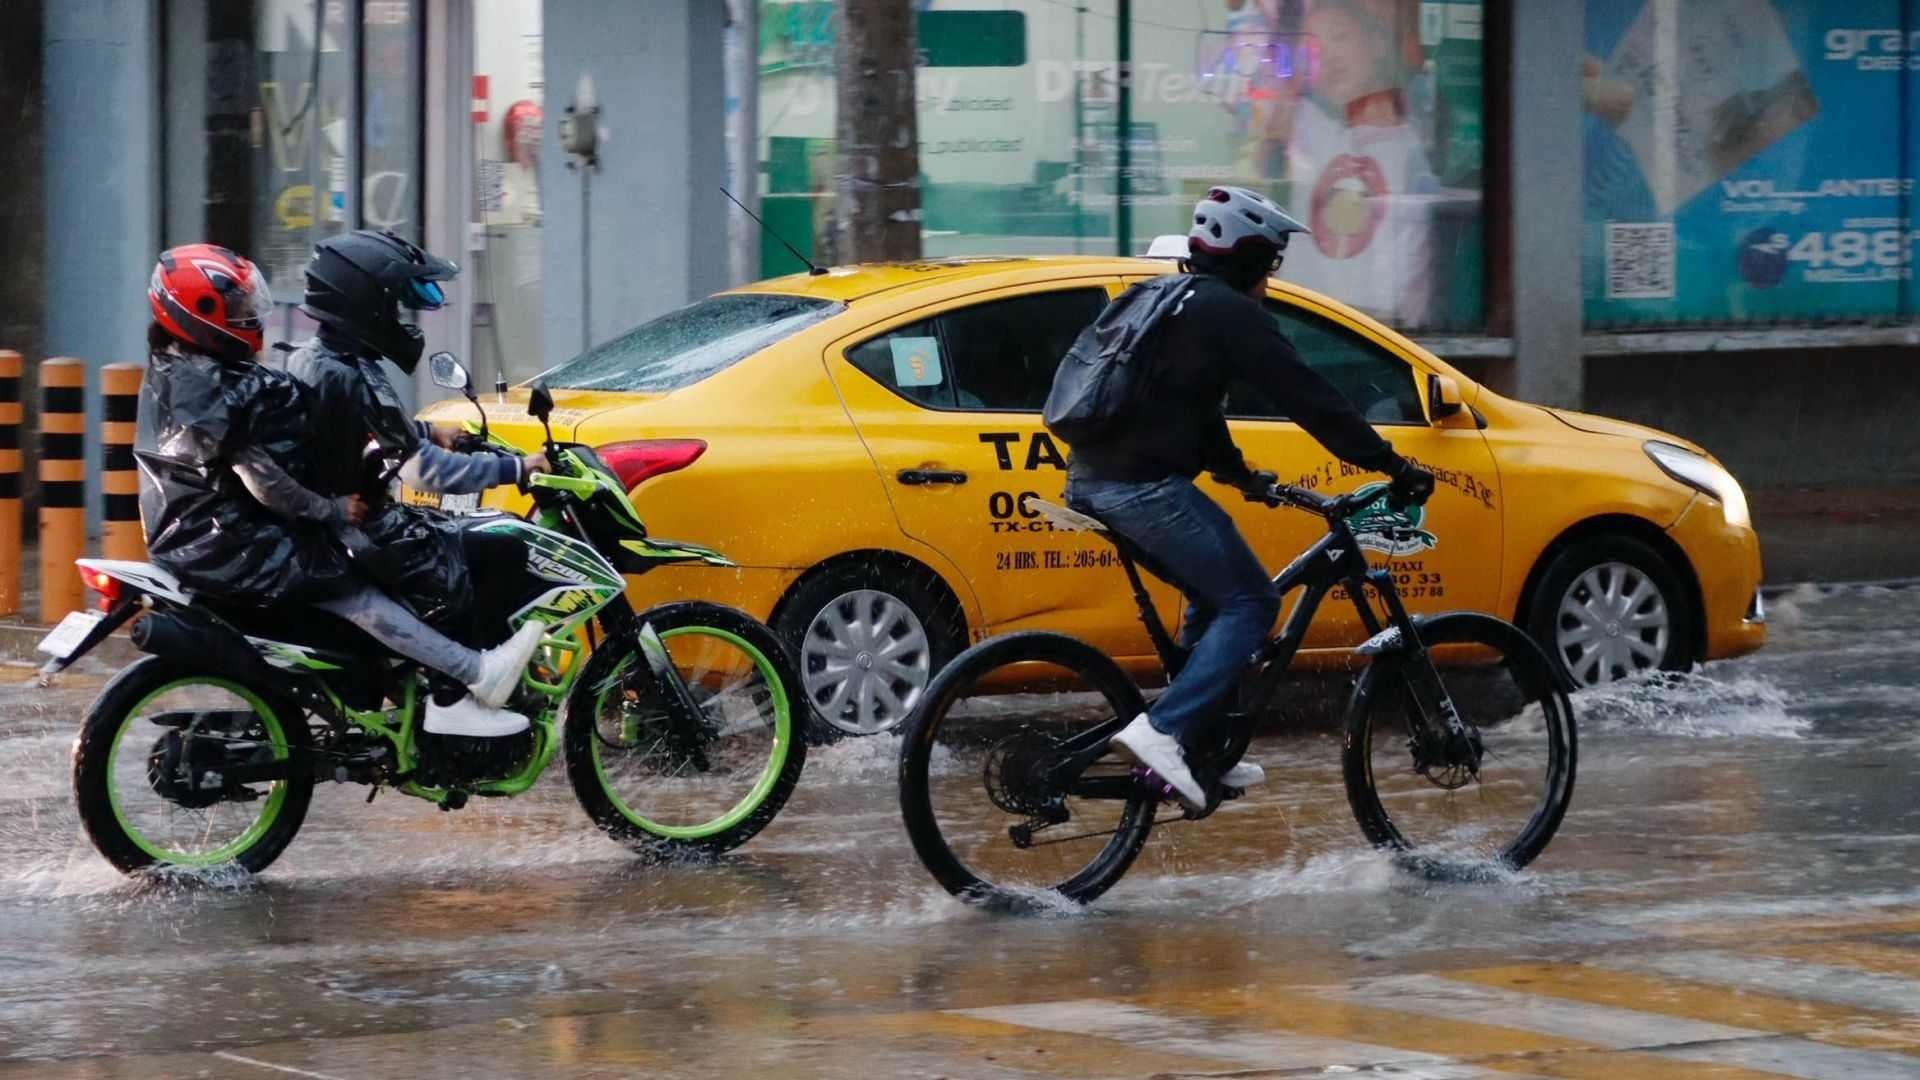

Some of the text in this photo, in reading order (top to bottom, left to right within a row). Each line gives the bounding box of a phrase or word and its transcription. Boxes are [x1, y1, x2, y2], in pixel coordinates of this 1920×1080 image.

[979, 432, 1067, 471] TA
[996, 552, 1011, 570] 24
[1015, 551, 1040, 569] HRS.
